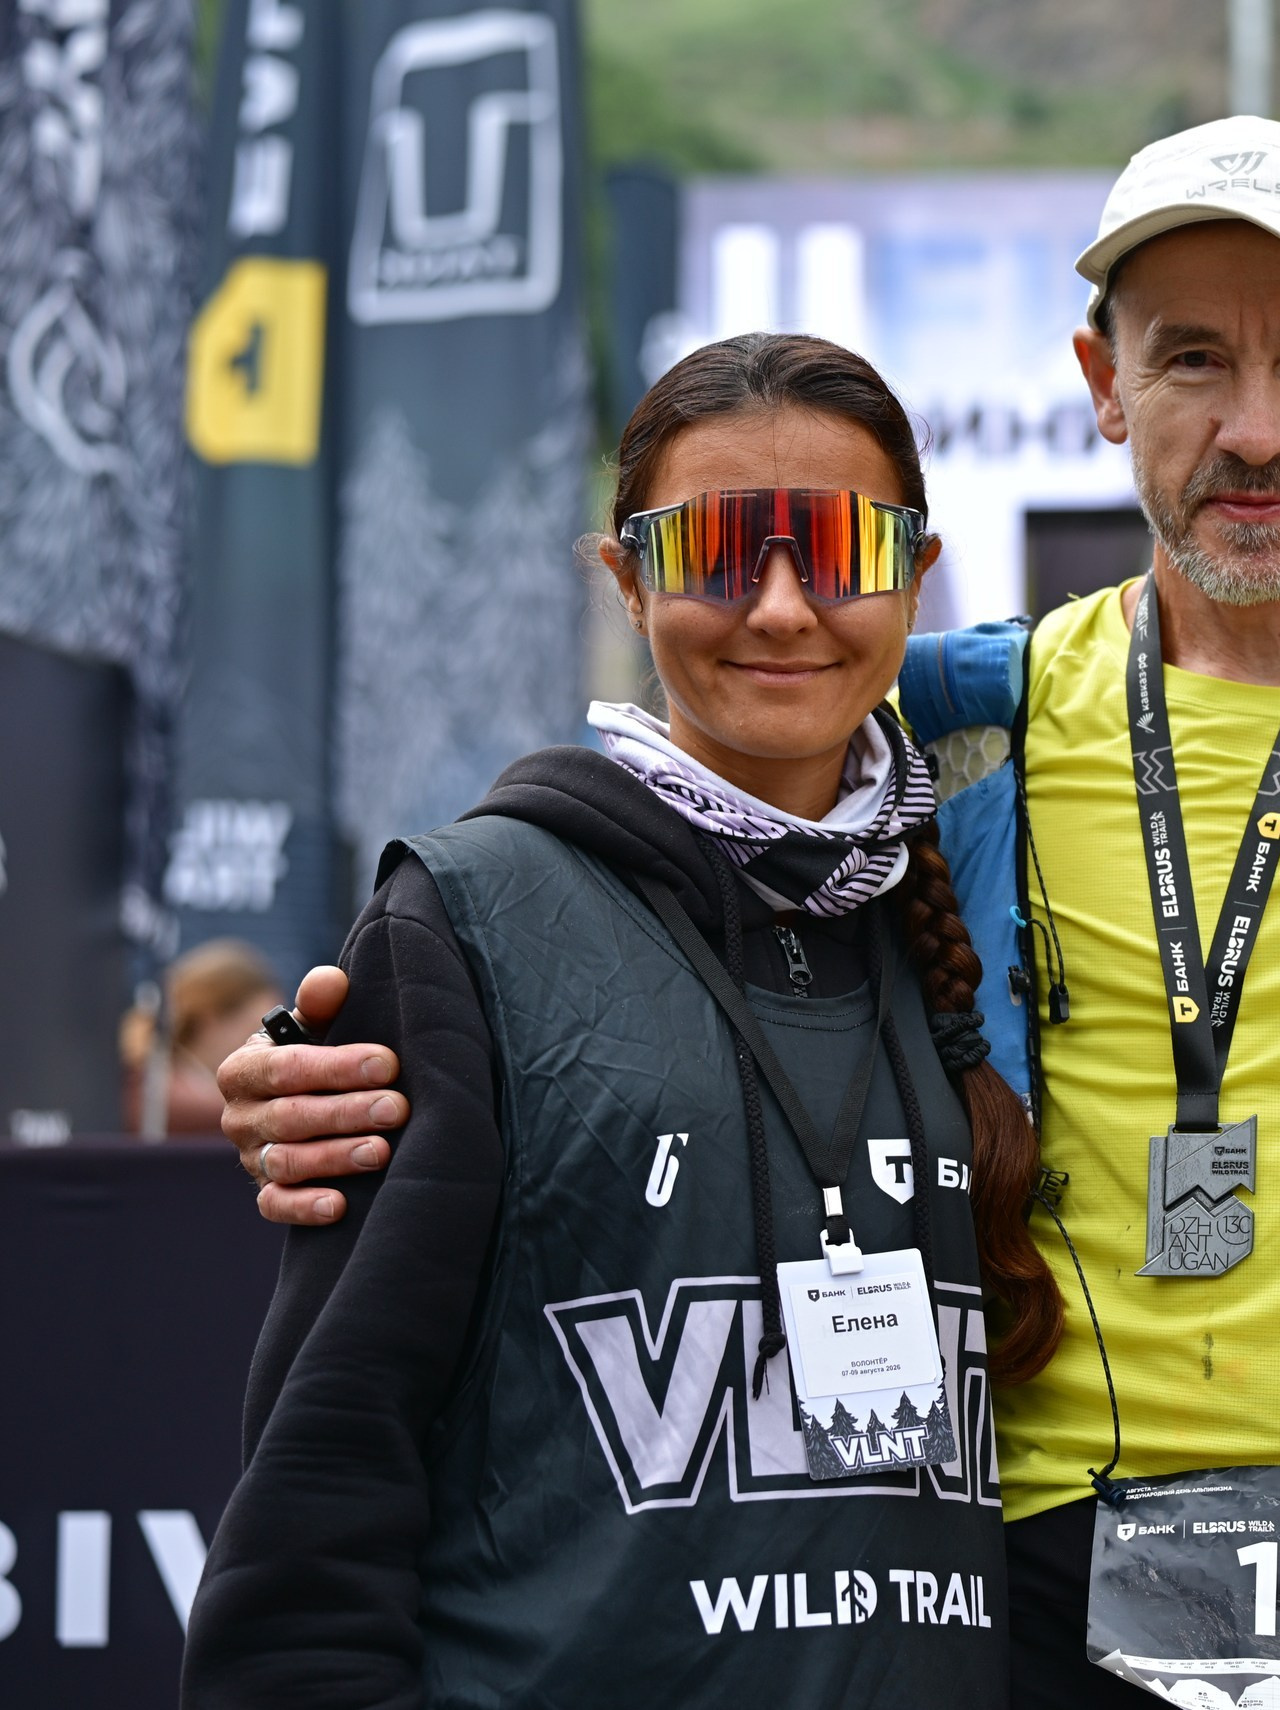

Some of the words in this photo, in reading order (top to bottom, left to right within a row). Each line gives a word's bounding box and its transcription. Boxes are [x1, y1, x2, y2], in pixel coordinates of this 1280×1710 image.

[1246, 841, 1271, 892] БАНК
[1155, 848, 1179, 917] ELBRUS
[1217, 915, 1251, 988] ELBRUS
[1170, 941, 1189, 991] БАНК
[1219, 991, 1231, 1018] WILD
[1212, 1161, 1249, 1169] ELBRUS
[1170, 1216, 1211, 1234] DZH
[1168, 1234, 1213, 1252] ANT
[1168, 1252, 1230, 1270] UGAN
[822, 1290, 846, 1298] БАНК
[857, 1284, 892, 1295] ELBRUS
[832, 1313, 898, 1333] Елена
[851, 1357, 888, 1367] ВОЛОНТЁР
[829, 1425, 929, 1469] VLNT
[1138, 1524, 1175, 1535] БАНК
[1193, 1520, 1246, 1534] ELBRUS
[689, 1569, 878, 1635] WILD
[889, 1568, 992, 1628] TRAIL
